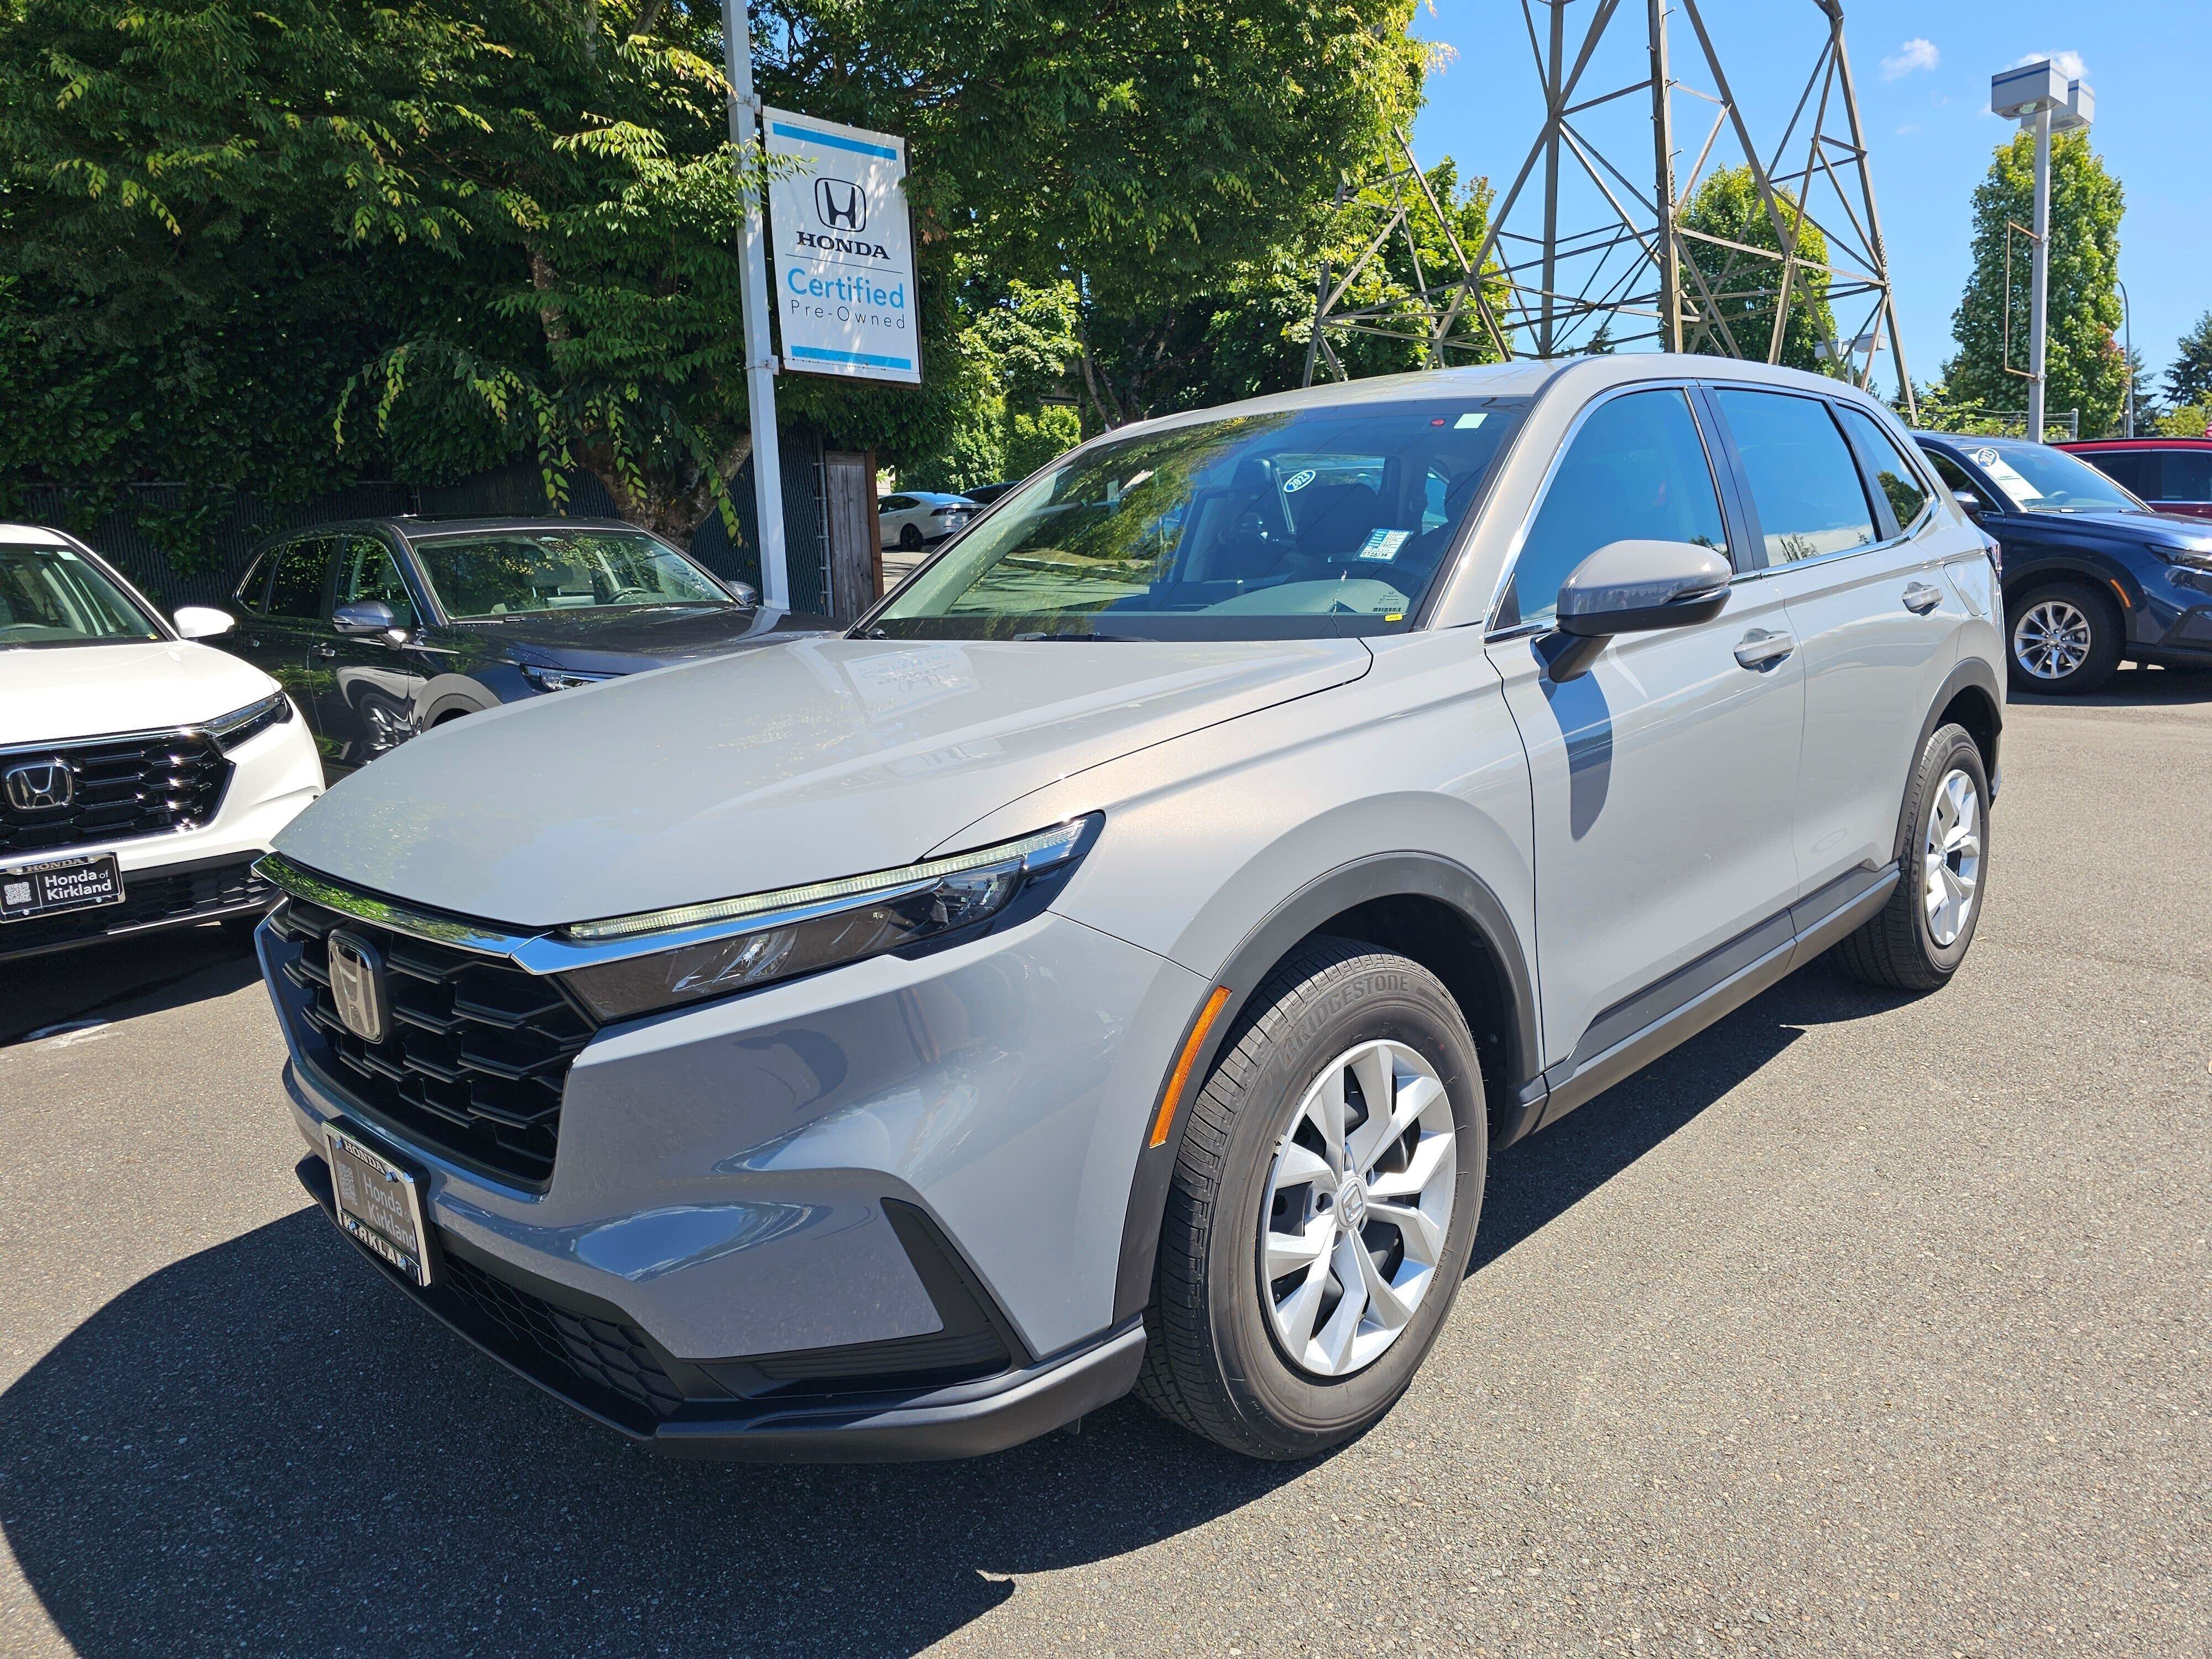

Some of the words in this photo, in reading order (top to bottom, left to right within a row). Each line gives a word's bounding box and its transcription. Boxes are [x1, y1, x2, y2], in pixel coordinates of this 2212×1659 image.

[796, 231, 891, 260] HONDA
[787, 268, 905, 309] Certified
[791, 299, 905, 330] Pre-Owned
[1288, 472, 1311, 490] 2023
[27, 858, 84, 872] HONDA
[44, 869, 97, 888] Honda
[99, 869, 109, 879] of
[46, 879, 112, 901] Kirkland
[1278, 974, 1409, 1071] BRIDGESTONE
[343, 1140, 385, 1173] HONDA
[363, 1172, 403, 1220] Honda
[367, 1201, 417, 1254] Kirkland
